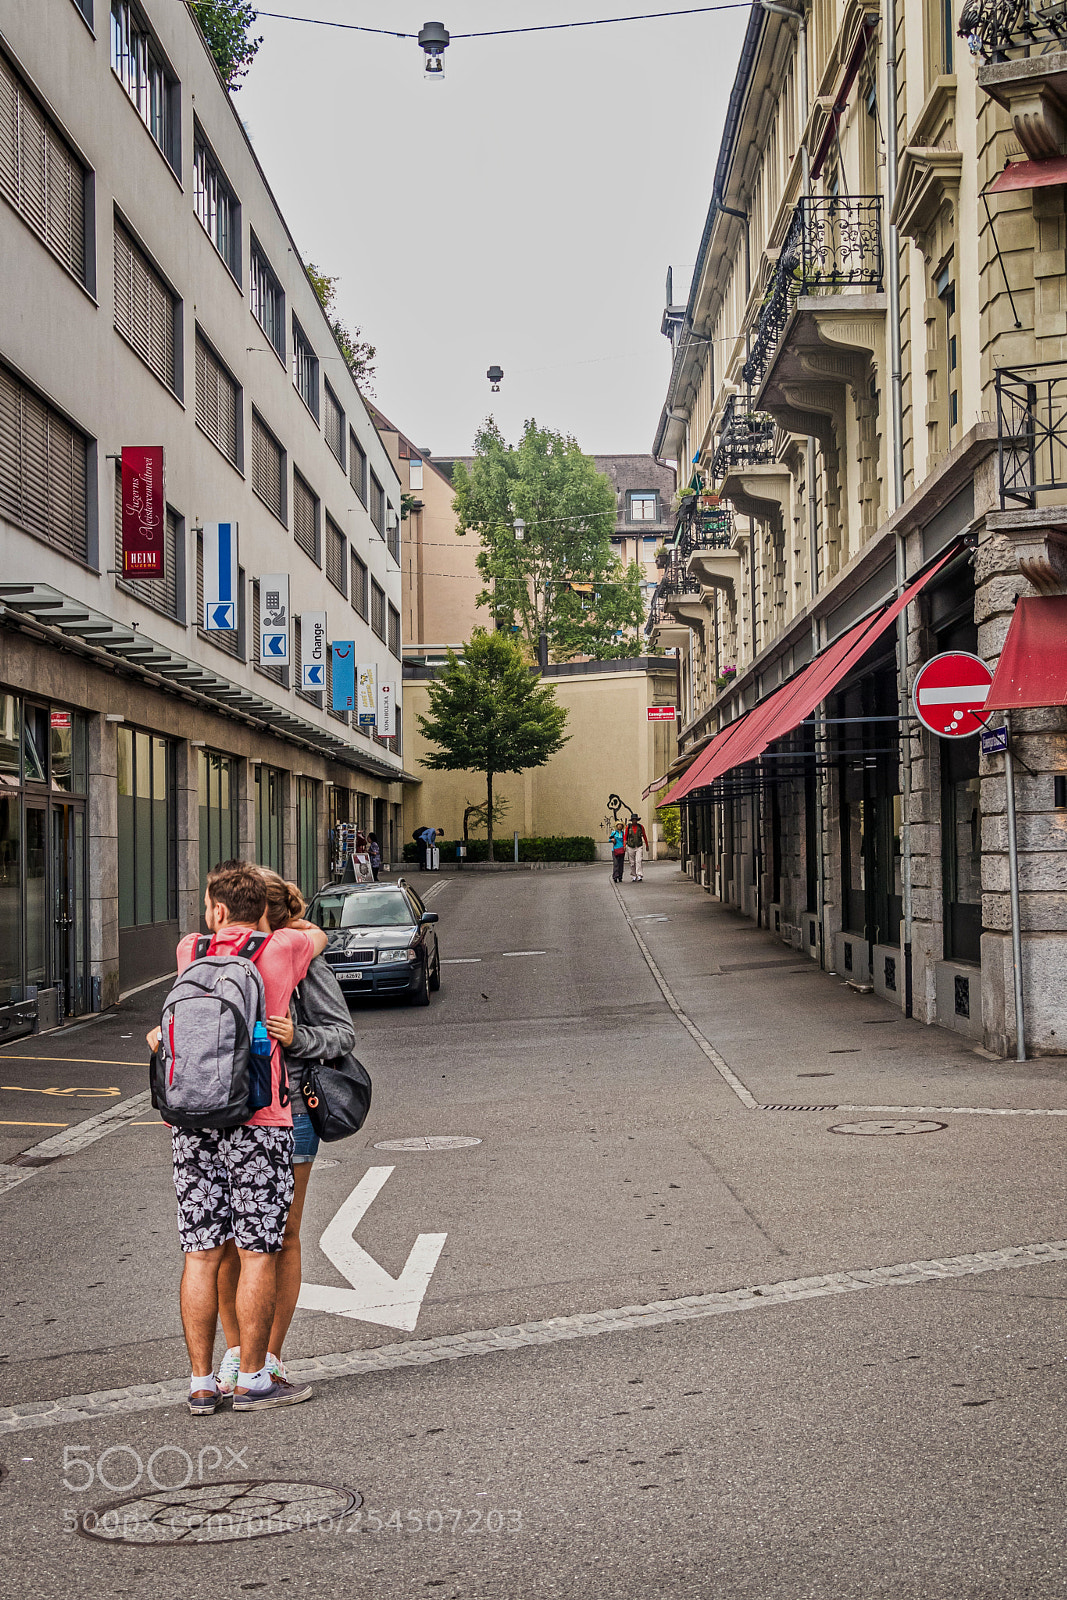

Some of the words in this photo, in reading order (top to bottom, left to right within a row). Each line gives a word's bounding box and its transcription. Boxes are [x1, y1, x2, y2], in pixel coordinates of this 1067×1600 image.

[126, 477, 143, 516] Luzerns
[131, 552, 156, 563] HEINI
[312, 623, 324, 660] Change
